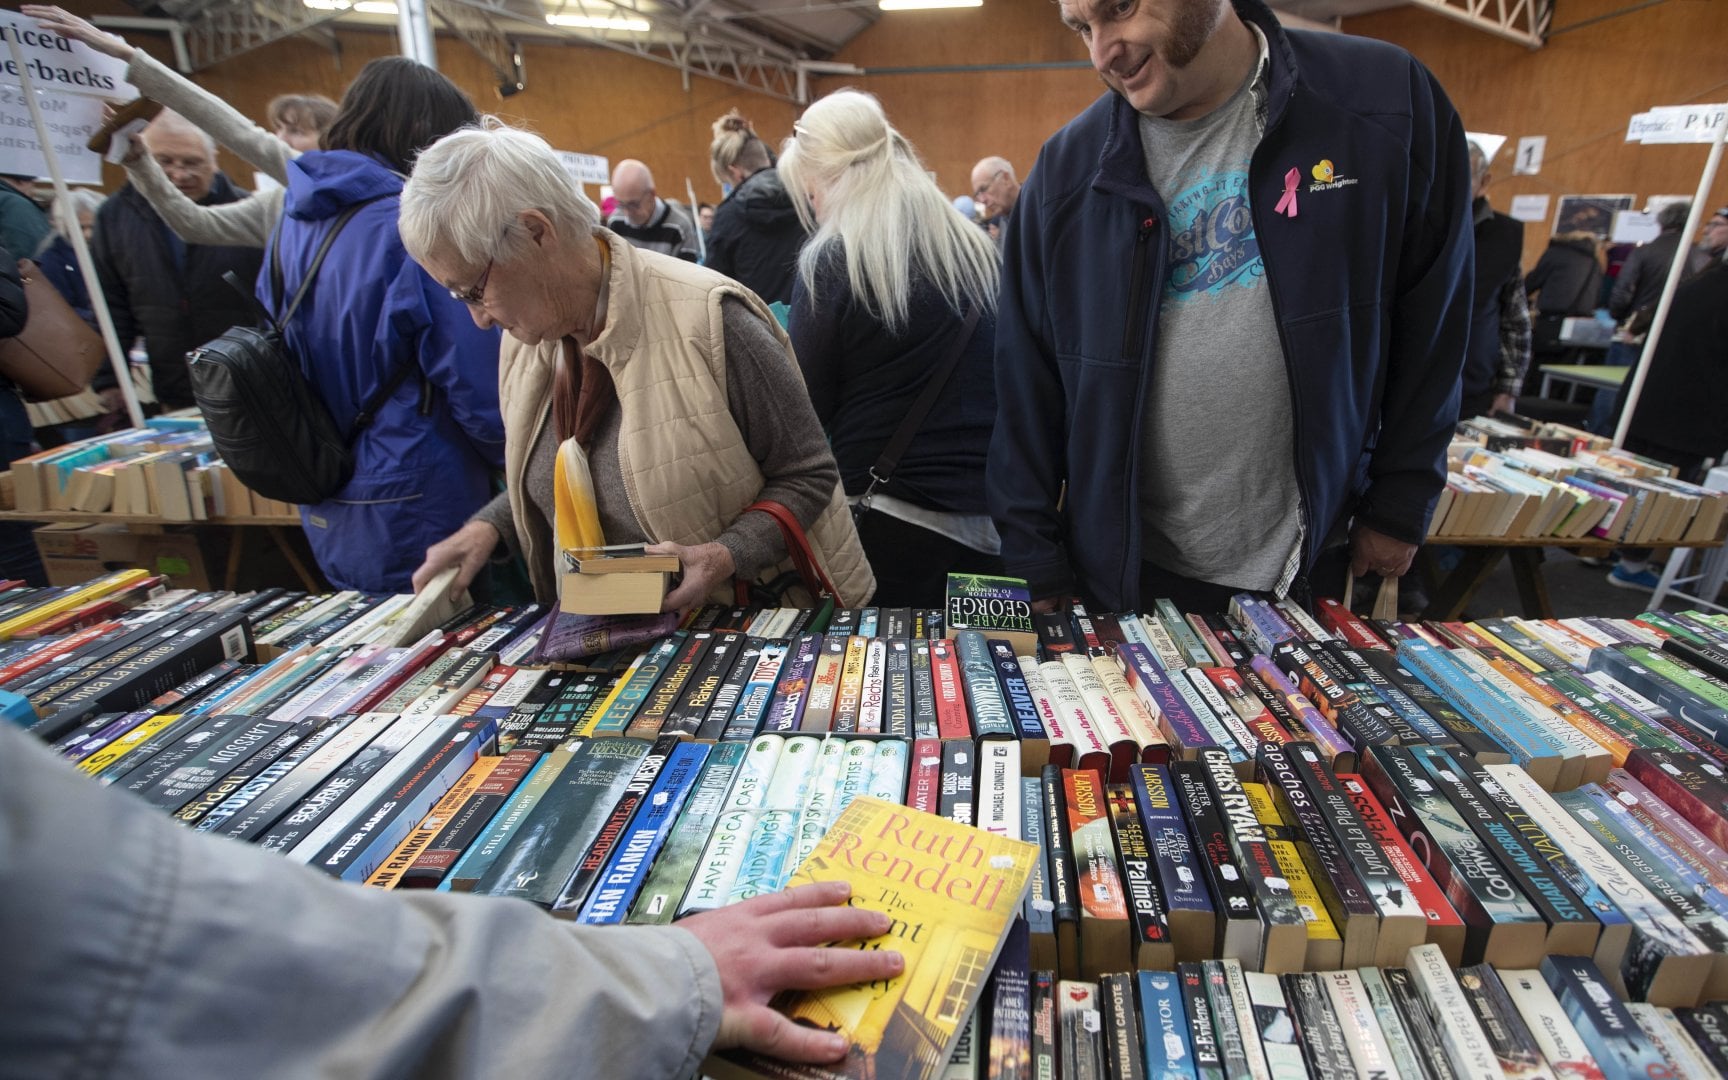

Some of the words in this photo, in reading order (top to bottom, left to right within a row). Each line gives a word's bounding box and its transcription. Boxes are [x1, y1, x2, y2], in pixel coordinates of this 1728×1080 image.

[1524, 145, 1535, 167] 1
[951, 597, 1031, 619] GEORGE
[951, 612, 1033, 631] ELIZABETH
[91, 646, 143, 672] Plante
[127, 645, 175, 670] Plante
[751, 661, 780, 681] TOYS
[1291, 650, 1311, 665] GIRL
[645, 690, 670, 715] David
[659, 663, 693, 694] Baldacci
[689, 675, 720, 707] Rankin
[862, 676, 883, 708] Reichs
[891, 673, 906, 703] LaPLANTE
[918, 670, 931, 695] Rendell
[1247, 672, 1273, 698] Criminals
[1303, 662, 1344, 699] CALIFORNIA
[1361, 666, 1388, 686] LETHAL
[602, 700, 635, 728] LEE
[623, 665, 660, 698] CHILD
[715, 684, 742, 708] WIDOW
[736, 687, 770, 721] Patterson
[779, 691, 803, 730] BALDACCI
[839, 677, 859, 714] REICHS
[918, 696, 930, 717] Ruth
[969, 676, 1008, 724] CORNWELL
[1005, 677, 1041, 730] DEAVER
[1267, 694, 1290, 717] Little
[1387, 686, 1423, 719] Fairstein
[837, 711, 853, 732] Kathy
[890, 704, 906, 736] LYNDA
[1174, 706, 1205, 742] Beautiful
[1353, 701, 1387, 736] PARKER
[1419, 715, 1447, 740] Linda
[208, 721, 279, 764] LARSSON
[588, 742, 644, 758] FORSYTH
[129, 762, 173, 790] BLACK
[394, 769, 426, 799] LOOKING
[625, 777, 649, 796] JO
[943, 772, 957, 796] CROSS
[957, 775, 973, 791] FIRE
[993, 760, 1005, 790] CONNELLY
[1140, 767, 1170, 811] LARSSON
[1203, 750, 1243, 794] CHRIS
[1264, 743, 1311, 808] apaches
[212, 762, 298, 818] FORSYTH
[261, 779, 302, 815] FIENNES
[288, 777, 353, 825] BOURNE
[914, 780, 929, 813] WATER
[992, 789, 1004, 821] MICHAEL
[1024, 781, 1036, 805] JAKE
[1072, 773, 1098, 817] LARSSON
[1180, 772, 1205, 817] ROBINSON
[1193, 781, 1212, 808] PETER
[1419, 790, 1440, 811] Port
[453, 794, 488, 832] COLLECTION
[481, 831, 506, 856] STILL
[500, 794, 536, 832] MIDNIGHT
[801, 792, 826, 841] POISON
[1220, 792, 1267, 843] RYAN
[1327, 792, 1356, 832] Plante
[1468, 797, 1493, 821] Dark
[325, 831, 361, 865] PETER
[359, 801, 397, 834] JAMES
[582, 796, 638, 871] HEADHUNTERS
[876, 812, 985, 870] Ruth
[1126, 819, 1149, 858] SECOND
[1155, 836, 1171, 858] FIRE
[1162, 826, 1183, 863] PLAYED
[1173, 832, 1191, 854] GIRL
[1212, 831, 1227, 853] Cold
[1345, 825, 1364, 844] La
[1483, 820, 1544, 875] MACBRIDE
[1504, 810, 1565, 861] VAULT
[386, 832, 432, 870] RANKIN
[697, 858, 727, 899] HAVE
[720, 833, 737, 856] HIS
[1357, 842, 1390, 876] Lynda
[1615, 843, 1660, 878] GROSS
[588, 888, 625, 920] IAN
[608, 829, 658, 885] RANKIN
[741, 851, 769, 900] GAUDY
[827, 831, 1006, 912] Rendell
[1053, 857, 1065, 880] AGATHA
[1087, 857, 1098, 881] Tattoo
[1391, 858, 1412, 883] LONGING
[879, 887, 915, 912] The
[1055, 879, 1068, 904] CHRISTIE
[1127, 860, 1155, 917] Palmer
[1527, 874, 1584, 921] STUART
[1656, 877, 1700, 917] ANDREW
[1226, 964, 1242, 990] PETERS
[1423, 949, 1449, 993] MURDER
[993, 1007, 1029, 1020] PATTERSON
[1112, 983, 1126, 1027] CAPOTE
[1232, 990, 1247, 1010] ELLIS
[1042, 997, 1053, 1045] monday
[1193, 996, 1214, 1046] Evidence
[1320, 1010, 1342, 1049] burglar
[1450, 1009, 1482, 1048] EXPERT
[1540, 1013, 1572, 1059] Gravity
[1119, 1029, 1132, 1080] TRUMAN
